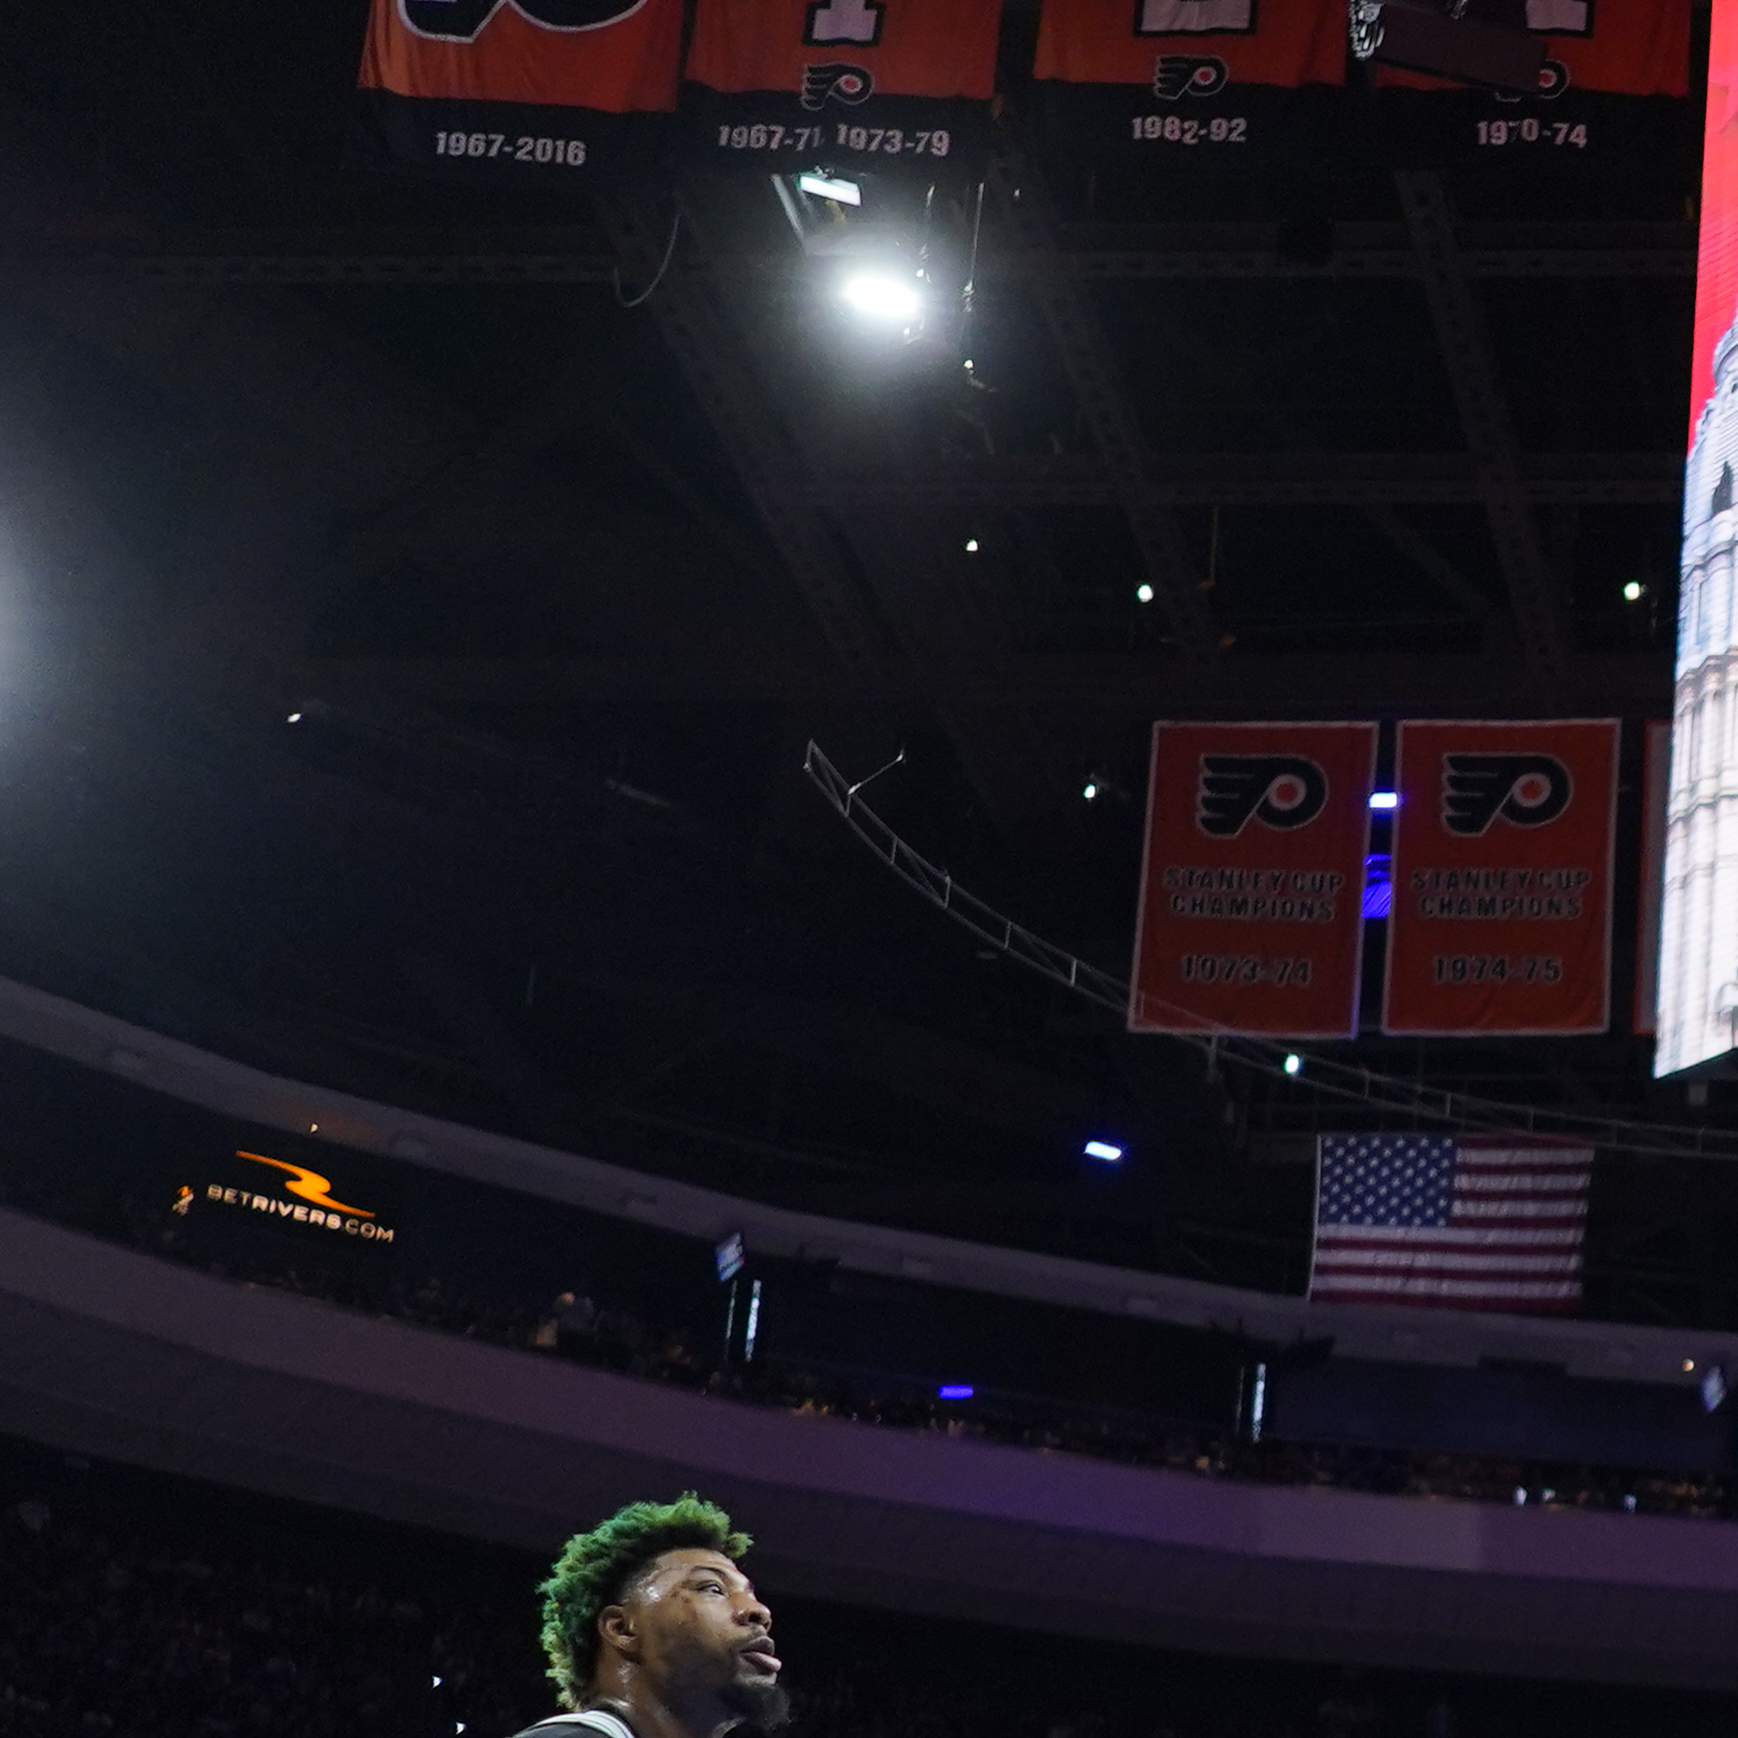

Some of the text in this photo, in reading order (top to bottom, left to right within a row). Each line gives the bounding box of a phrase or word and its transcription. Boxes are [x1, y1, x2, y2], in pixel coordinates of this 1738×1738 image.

[836, 122, 951, 158] 1973-79
[1131, 115, 1248, 145] 1982-92
[435, 130, 588, 167] 1967-2016
[1163, 866, 1346, 895] STANLEY CUP
[1411, 867, 1593, 894] STANLEY CUP
[1169, 894, 1338, 923] CHAMPIONS
[1418, 894, 1585, 921] CHAMPIONS
[206, 1184, 395, 1243] BETRIVERS.COM
